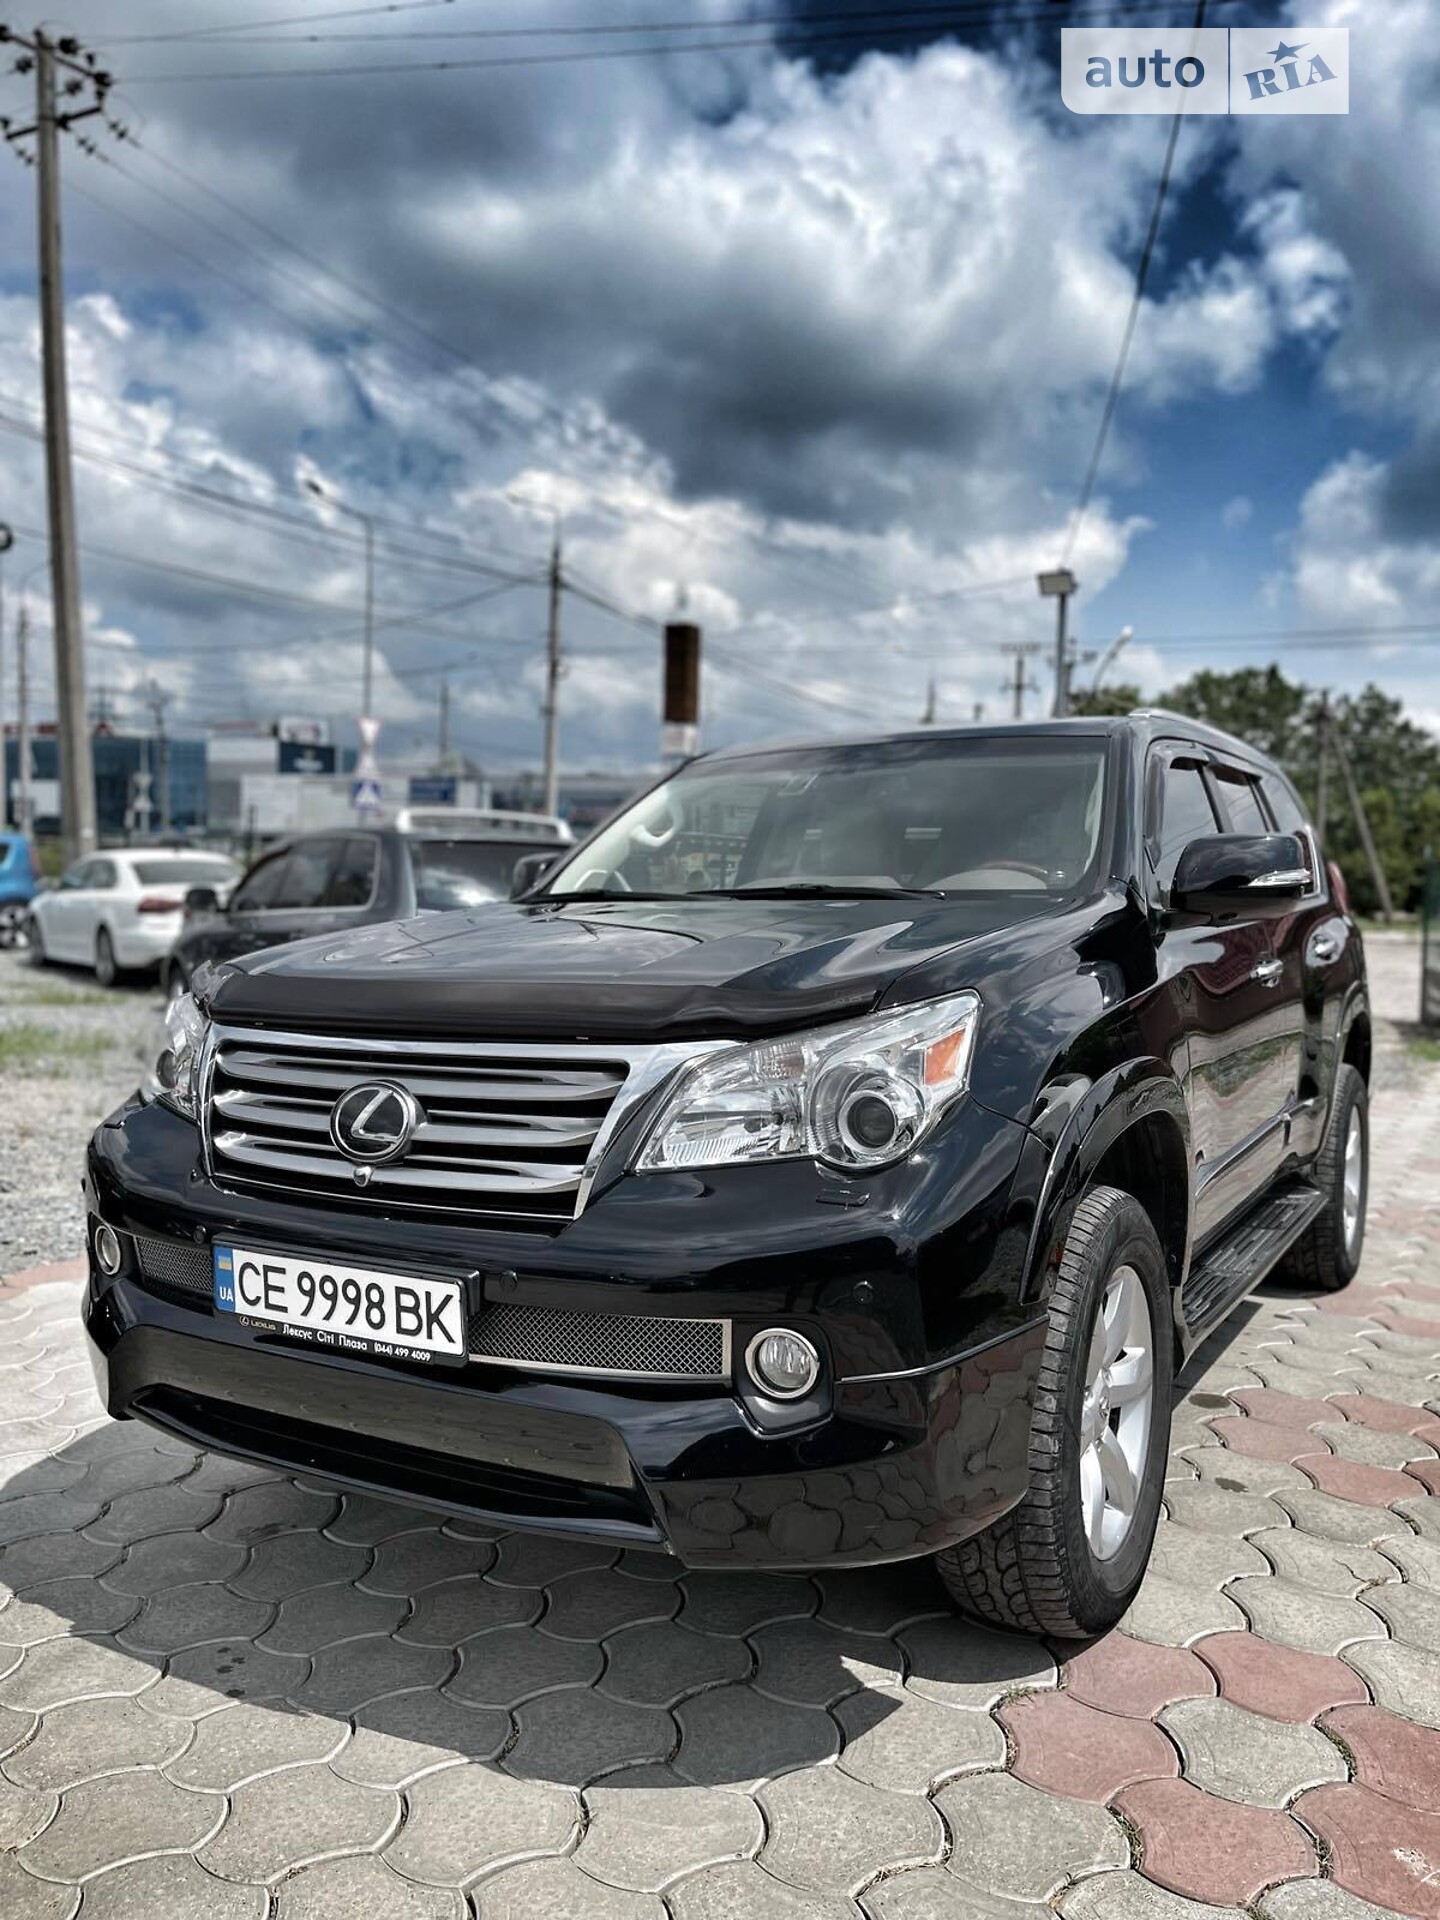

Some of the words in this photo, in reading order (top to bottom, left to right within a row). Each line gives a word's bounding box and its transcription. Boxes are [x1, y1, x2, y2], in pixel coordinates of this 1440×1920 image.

[219, 1287, 234, 1303] UA
[238, 1262, 288, 1313] CE
[297, 1271, 386, 1330] 9998
[395, 1286, 456, 1344] BK
[394, 1347, 409, 1357] 499
[411, 1350, 431, 1361] 4009
